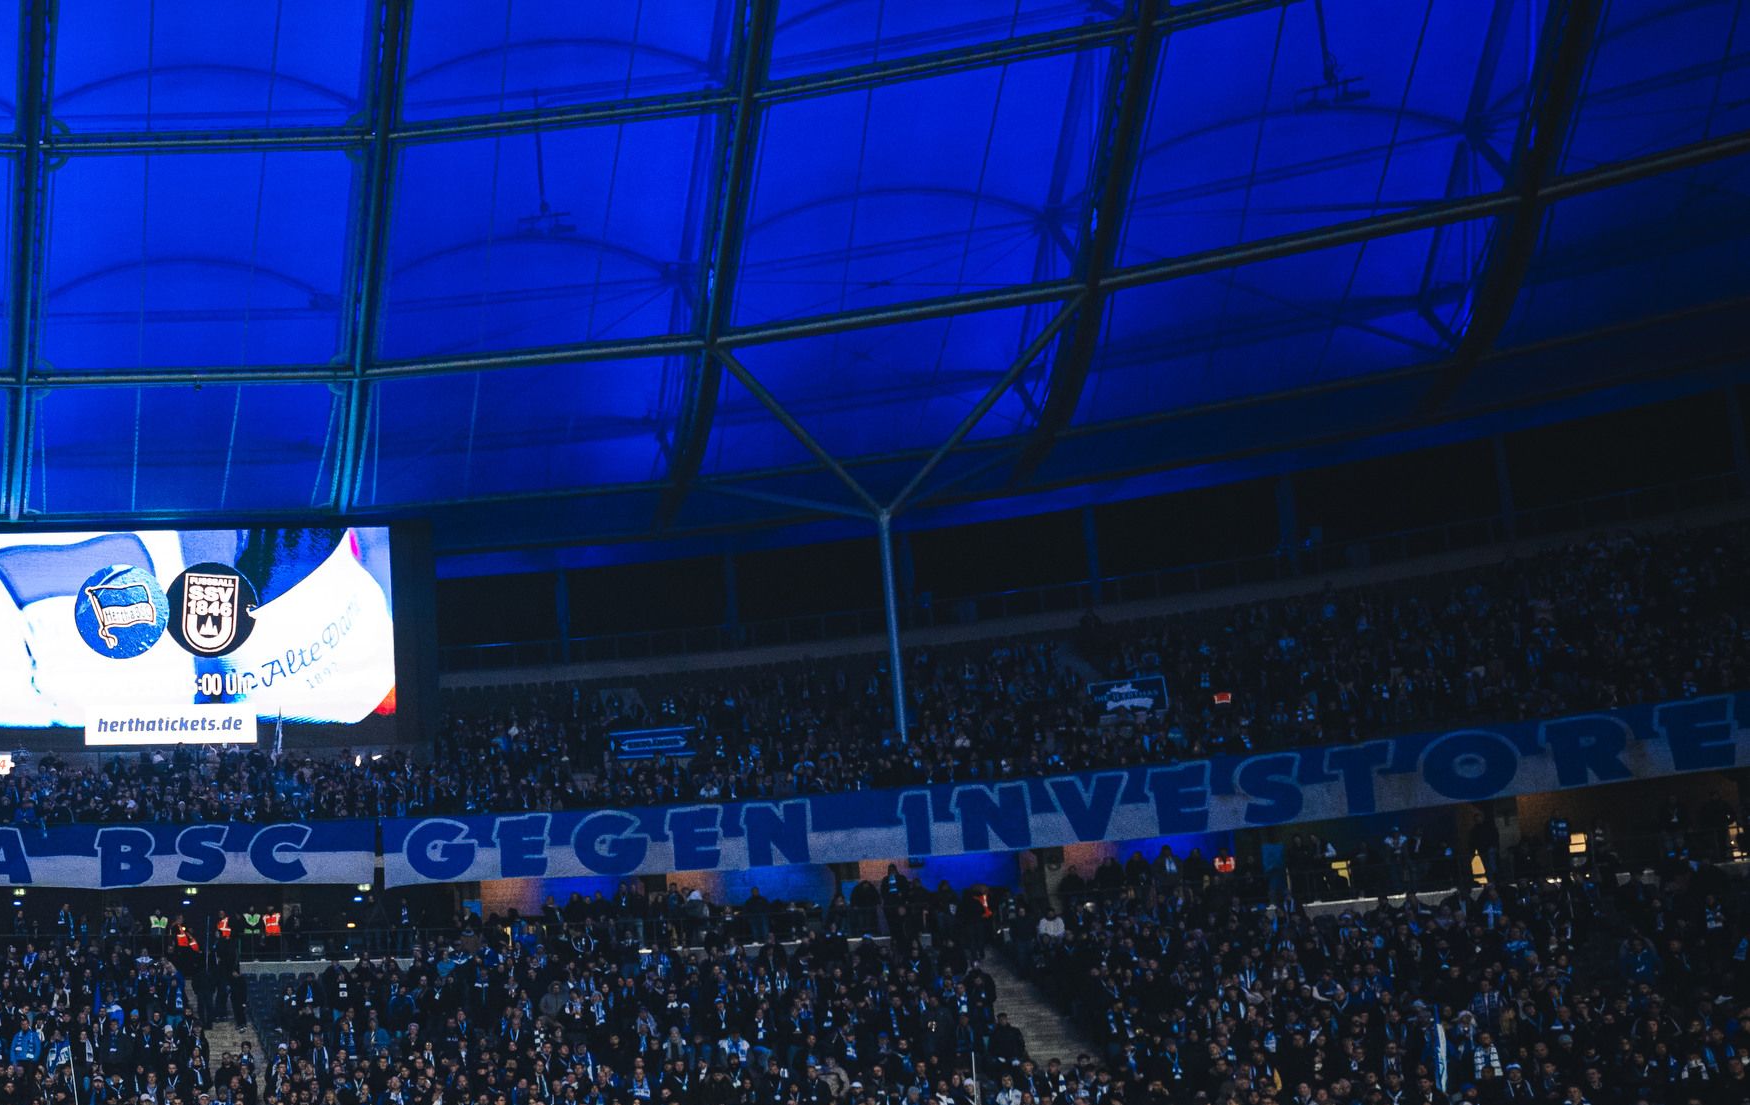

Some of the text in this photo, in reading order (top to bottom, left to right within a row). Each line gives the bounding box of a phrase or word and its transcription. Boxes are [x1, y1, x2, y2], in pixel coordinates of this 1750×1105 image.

[188, 585, 234, 603] SSV
[187, 600, 233, 617] 1846
[260, 642, 322, 688] Alte
[97, 716, 243, 733] herthatickets.de
[94, 823, 313, 888] BSC
[405, 797, 814, 880] GEGEN
[897, 693, 1740, 857] INVESTORE
